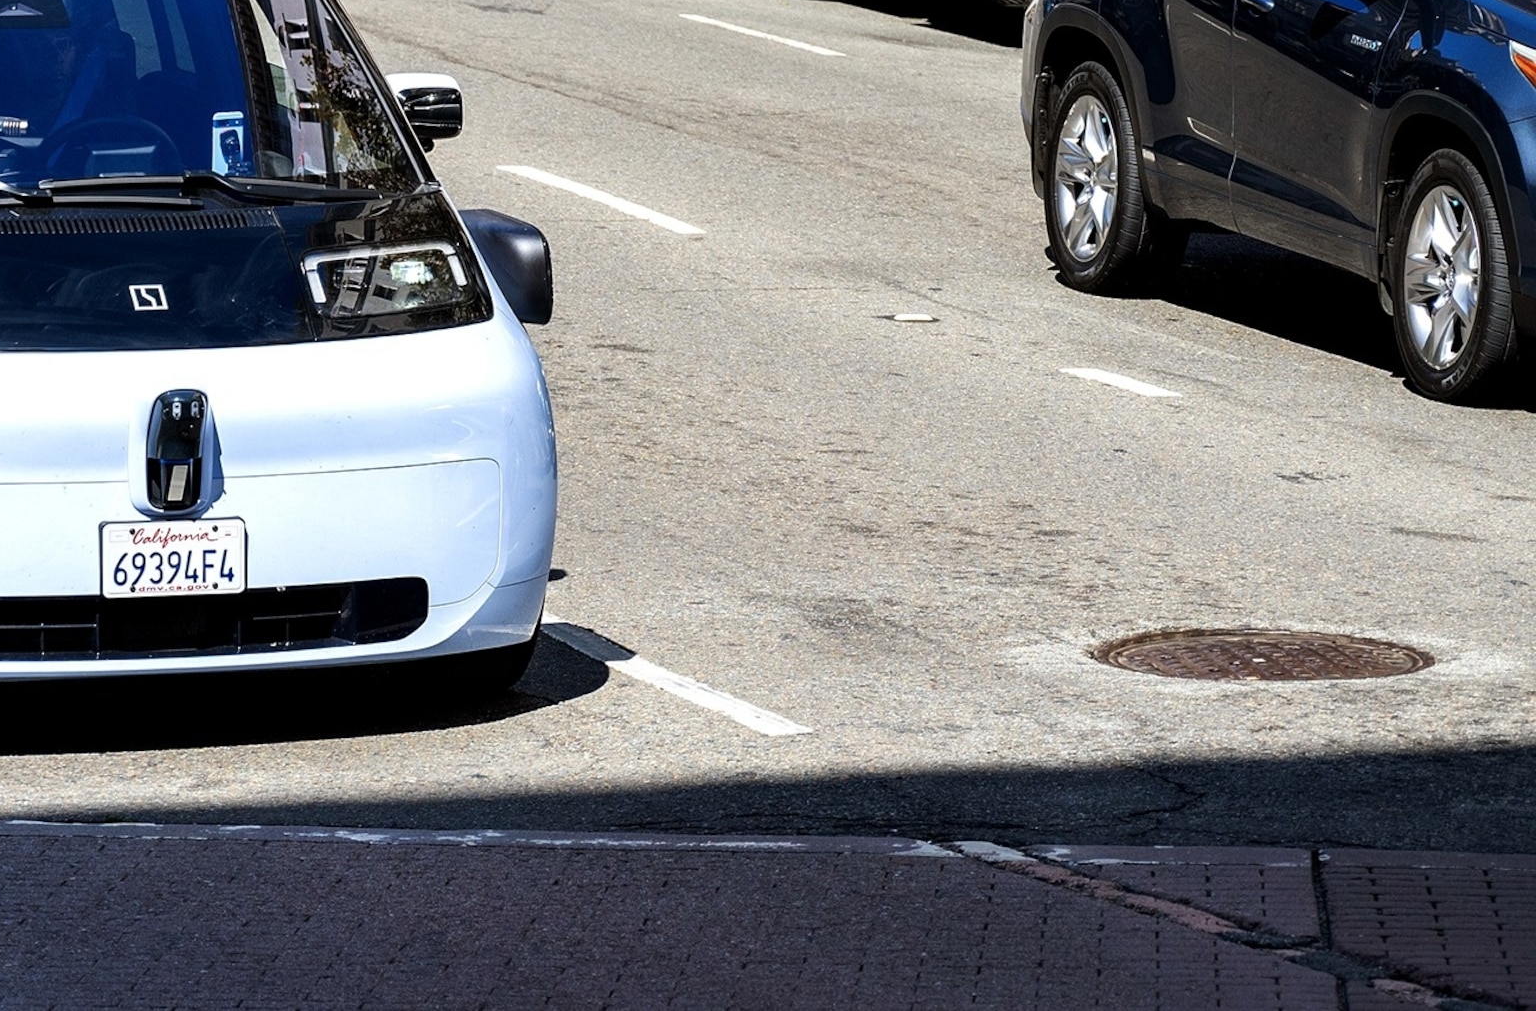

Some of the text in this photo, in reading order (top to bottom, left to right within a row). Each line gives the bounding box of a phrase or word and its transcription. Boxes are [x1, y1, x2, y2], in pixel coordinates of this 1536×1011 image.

[132, 528, 218, 549] California
[113, 550, 235, 586] 69394F4
[138, 584, 209, 593] dmv.ca.gov
